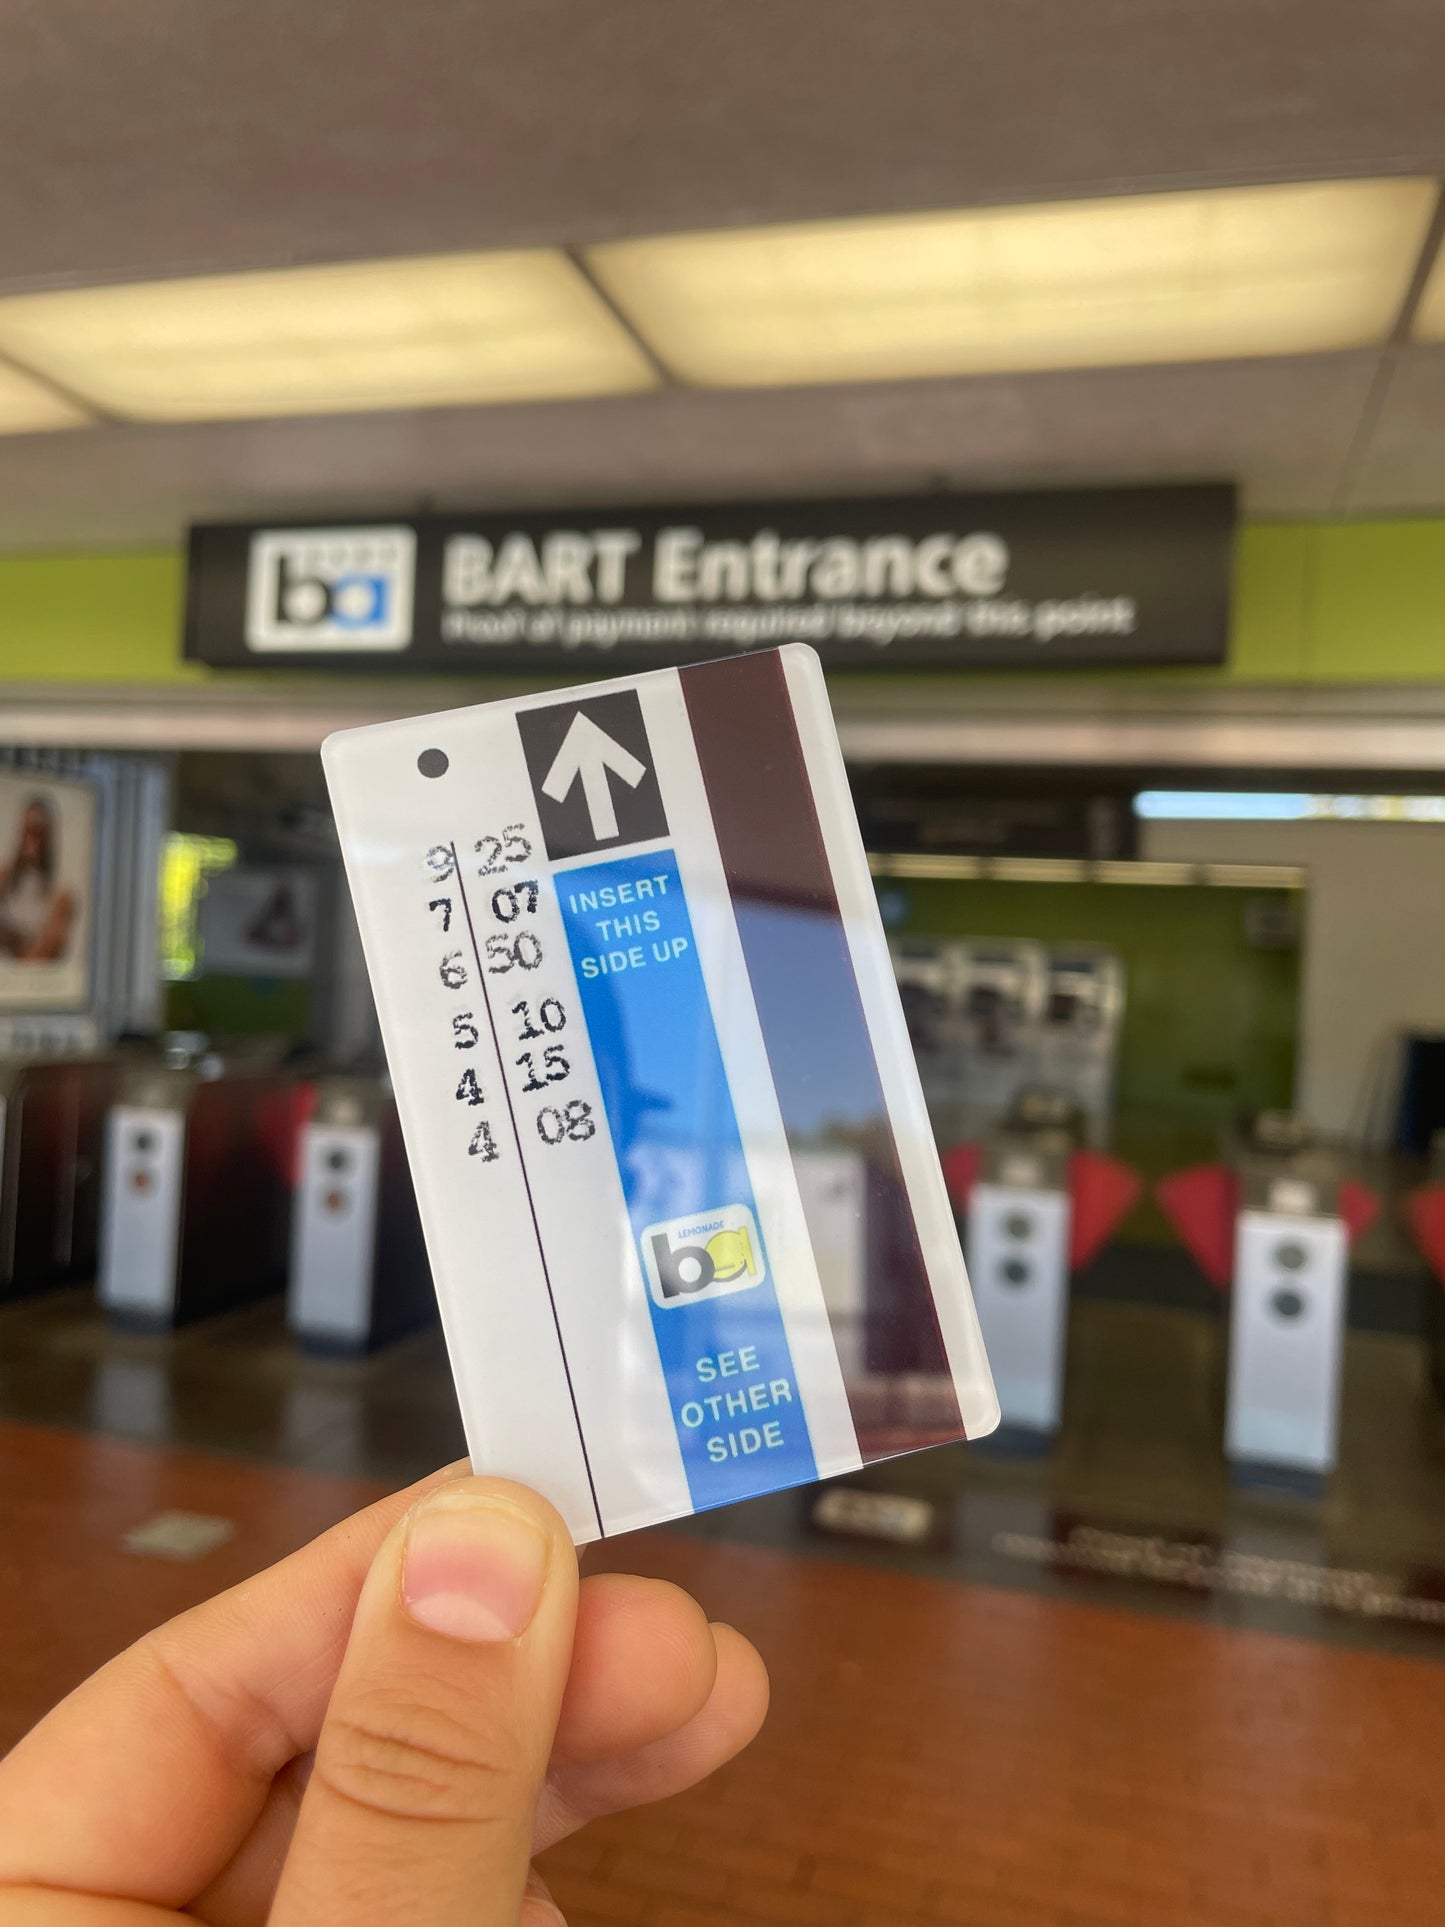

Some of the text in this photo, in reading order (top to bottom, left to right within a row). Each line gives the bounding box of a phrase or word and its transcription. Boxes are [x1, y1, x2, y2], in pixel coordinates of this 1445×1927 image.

[443, 527, 1009, 603] BART Entrance
[423, 823, 533, 883] 9 25
[429, 881, 539, 932] 7 07
[569, 874, 669, 915] INSERT
[595, 910, 661, 942] THIS
[439, 930, 544, 990] 6 50
[580, 937, 689, 979] SIDE UP
[452, 996, 567, 1050] 5 10
[456, 1044, 571, 1106] 4 15
[468, 1099, 596, 1163] 4 08
[678, 1220, 725, 1239] LEMONADE
[696, 1345, 760, 1383] SEE
[681, 1378, 793, 1428] OTHER
[706, 1421, 785, 1463] SIDE
